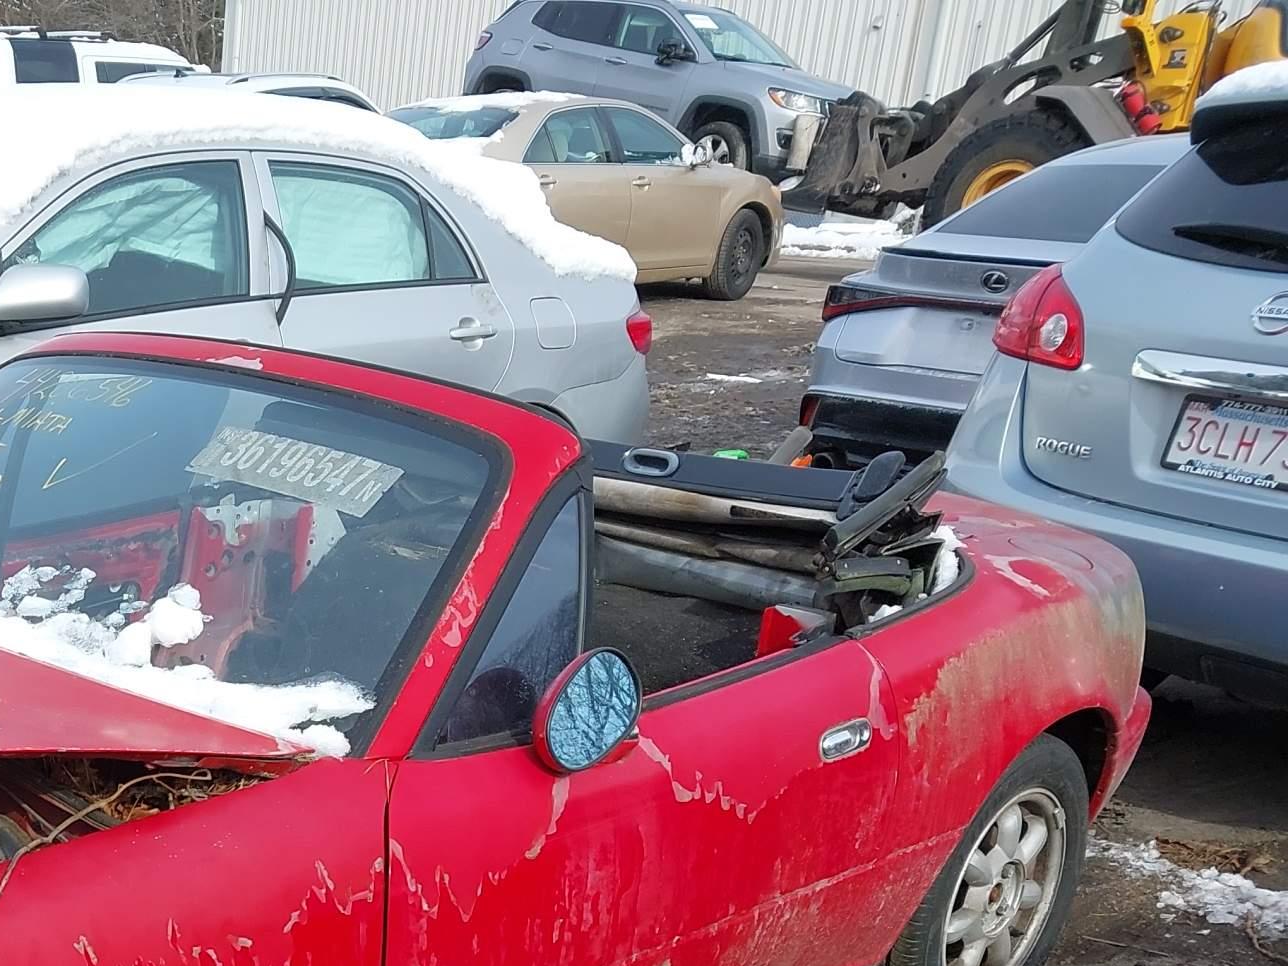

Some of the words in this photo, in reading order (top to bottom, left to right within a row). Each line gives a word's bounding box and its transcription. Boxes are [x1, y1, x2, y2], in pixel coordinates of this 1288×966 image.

[1035, 436, 1093, 459] ROGUE
[1177, 416, 1261, 463] 3CLH
[1178, 464, 1224, 479] ATLANTIS
[1225, 473, 1252, 484] AUTO
[1254, 478, 1279, 489] CITY
